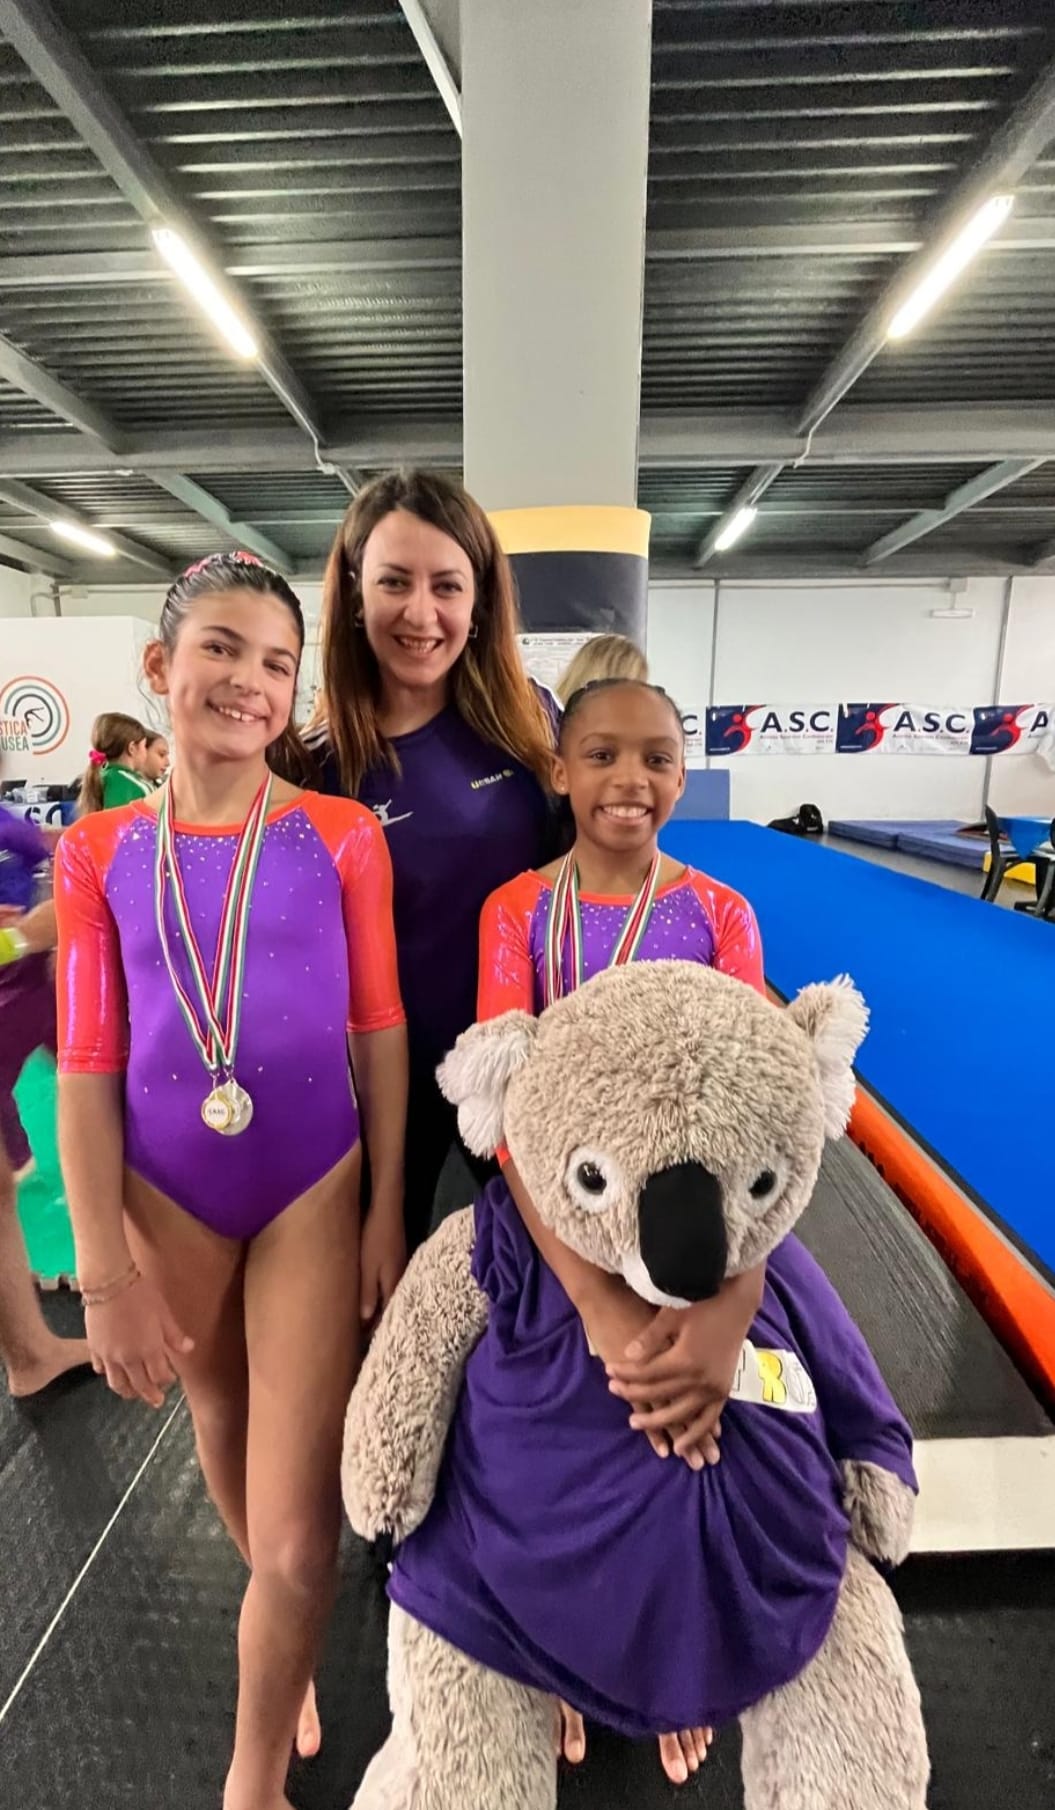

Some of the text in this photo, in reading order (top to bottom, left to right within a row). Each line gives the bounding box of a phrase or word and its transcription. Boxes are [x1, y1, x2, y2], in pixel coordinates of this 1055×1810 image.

[761, 711, 833, 732] A.S.C.
[893, 711, 969, 733] A.S.C.
[0, 736, 29, 751] USEA
